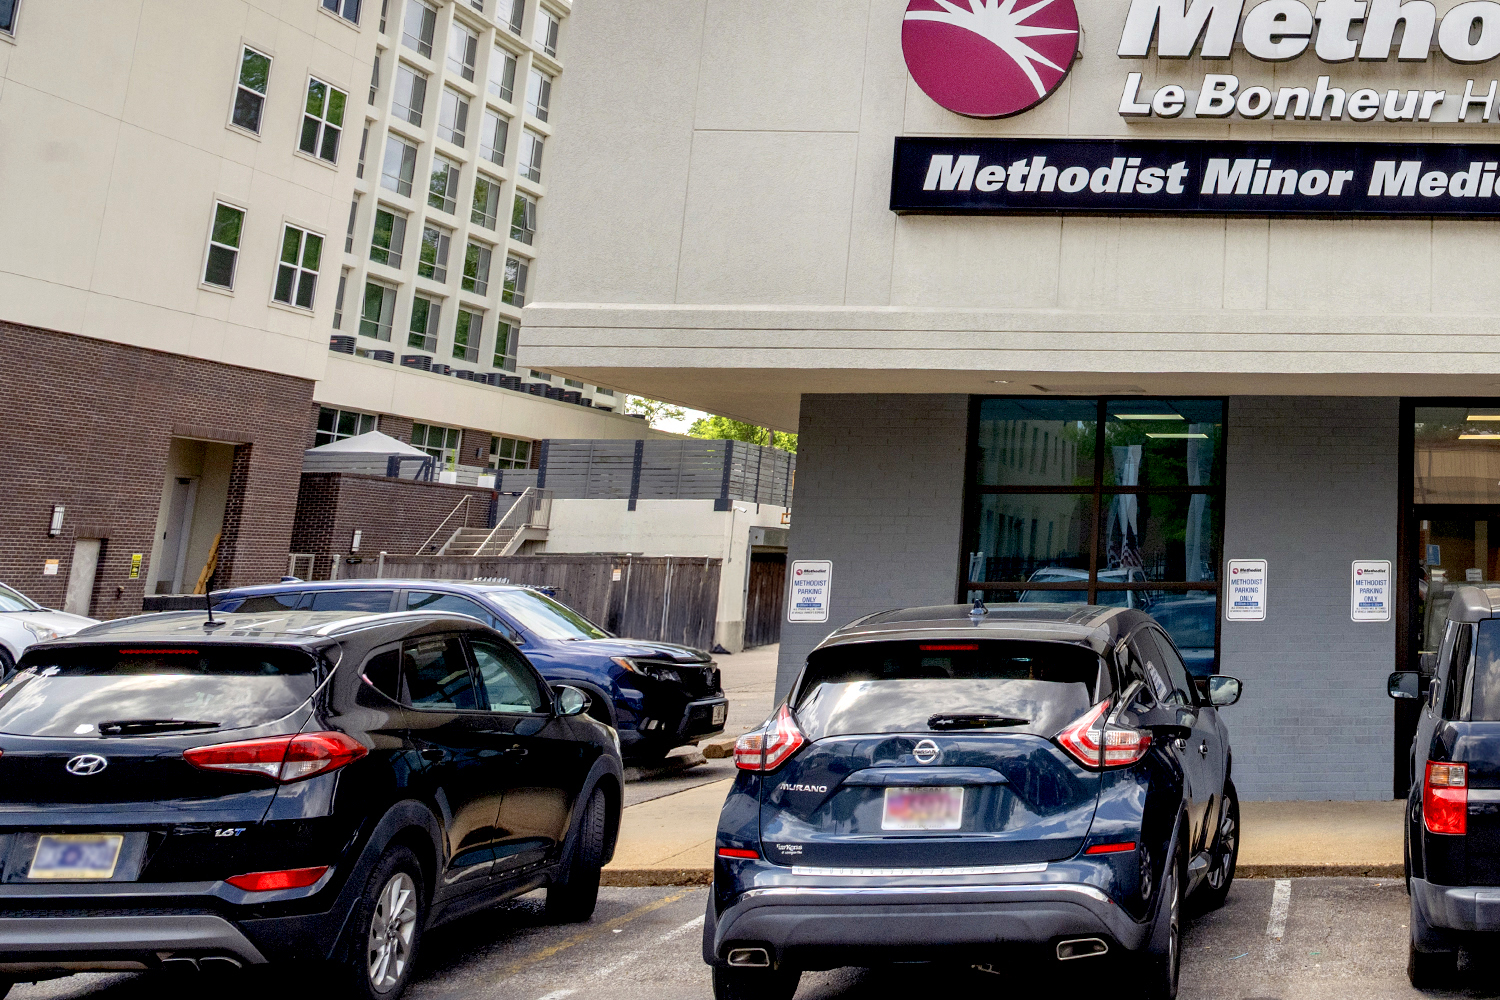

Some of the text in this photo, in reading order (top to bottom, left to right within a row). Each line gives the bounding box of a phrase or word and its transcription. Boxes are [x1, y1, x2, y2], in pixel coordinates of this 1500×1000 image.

[1118, 72, 1186, 118] Le
[1195, 74, 1446, 123] Bonheur
[923, 155, 1189, 194] Methodist
[1201, 158, 1353, 196] Minor
[780, 783, 828, 793] MURANO
